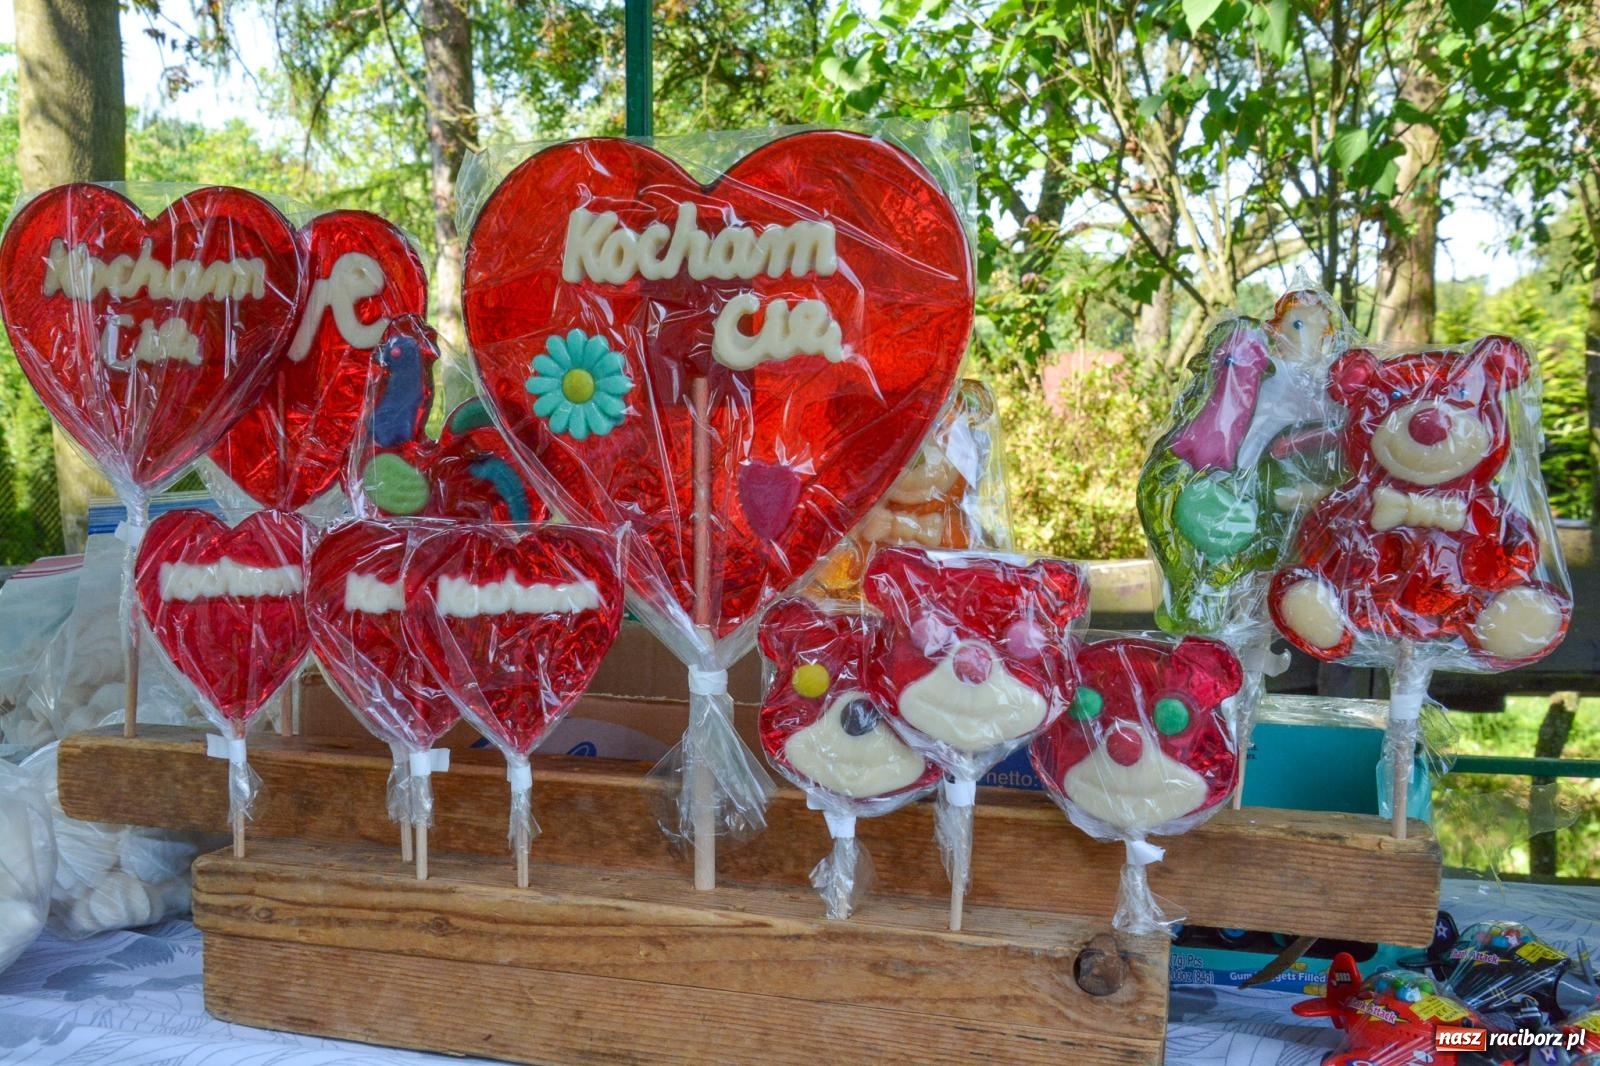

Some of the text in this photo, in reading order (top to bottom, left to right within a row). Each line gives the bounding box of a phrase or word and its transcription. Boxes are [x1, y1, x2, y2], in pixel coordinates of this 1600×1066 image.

[43, 237, 268, 301] Kocham
[562, 201, 838, 286] Kocham
[1298, 972, 1326, 983] Filled
